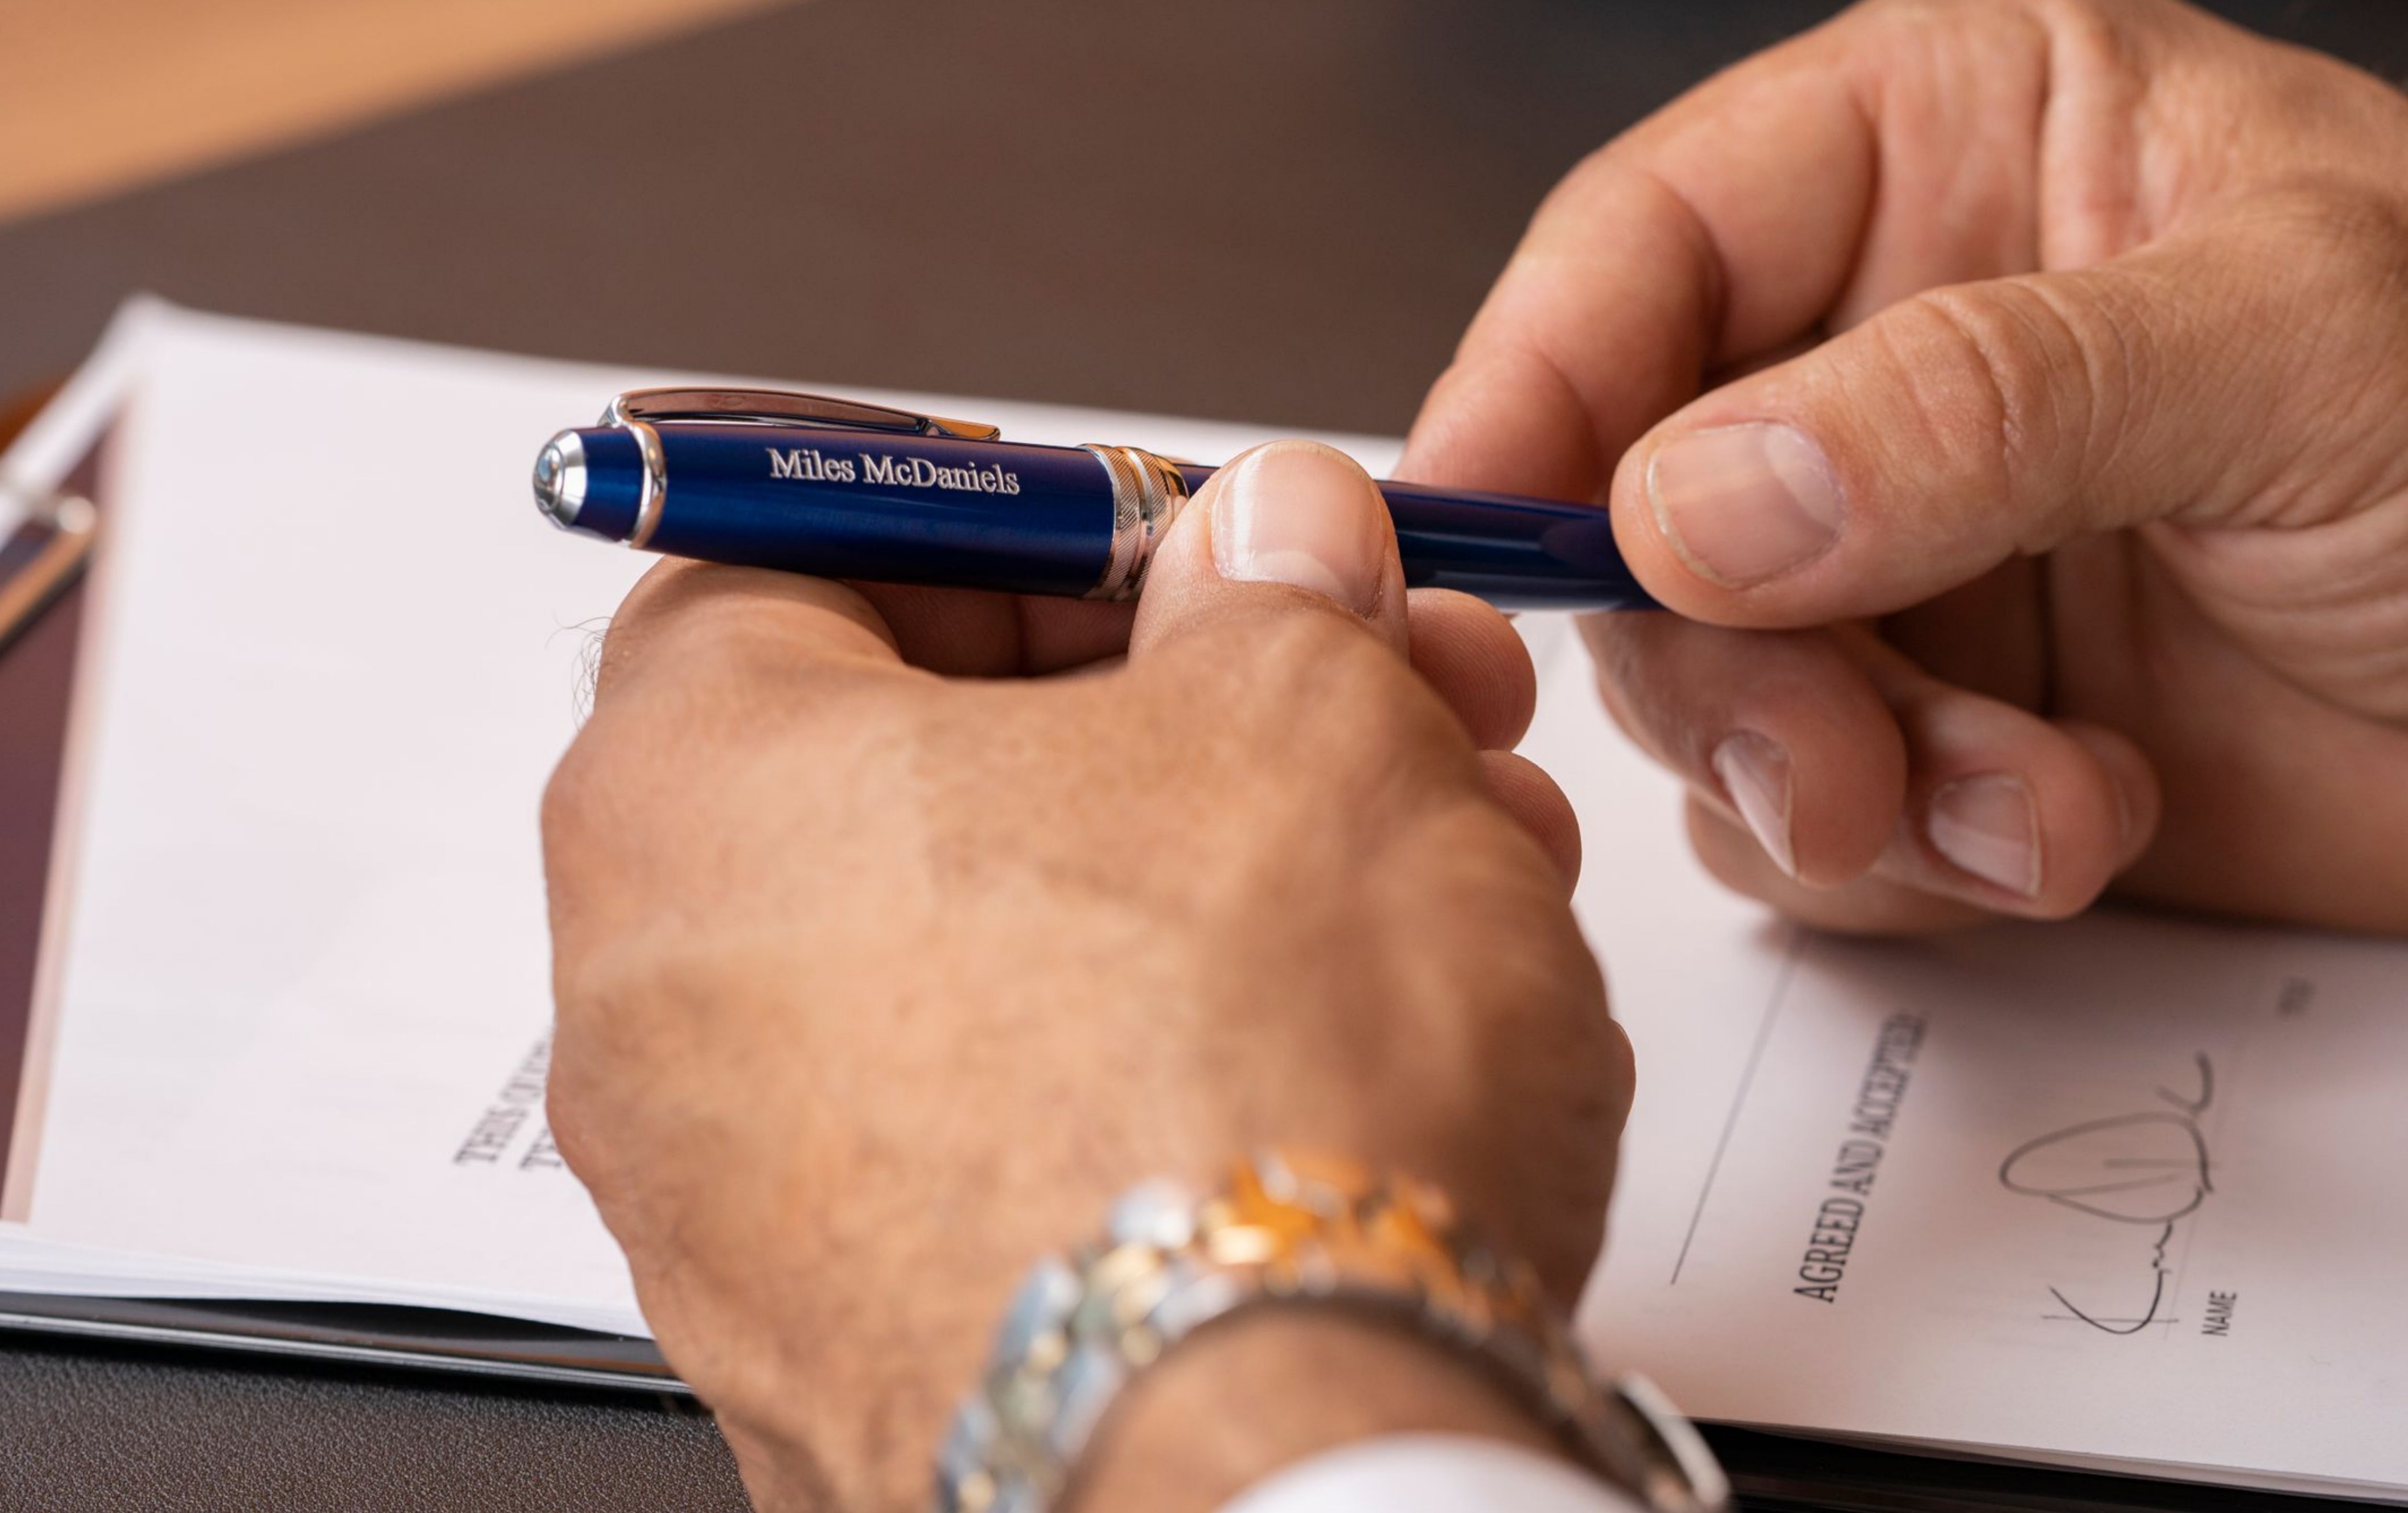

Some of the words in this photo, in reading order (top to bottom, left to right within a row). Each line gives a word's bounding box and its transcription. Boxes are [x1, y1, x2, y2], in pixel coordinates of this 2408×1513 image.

[766, 448, 856, 482] Miles
[859, 453, 1020, 496] McDaniels
[1793, 1197, 1865, 1304] AGREED
[1829, 1139, 1885, 1197] AND
[2201, 1290, 2237, 1337] NAME
